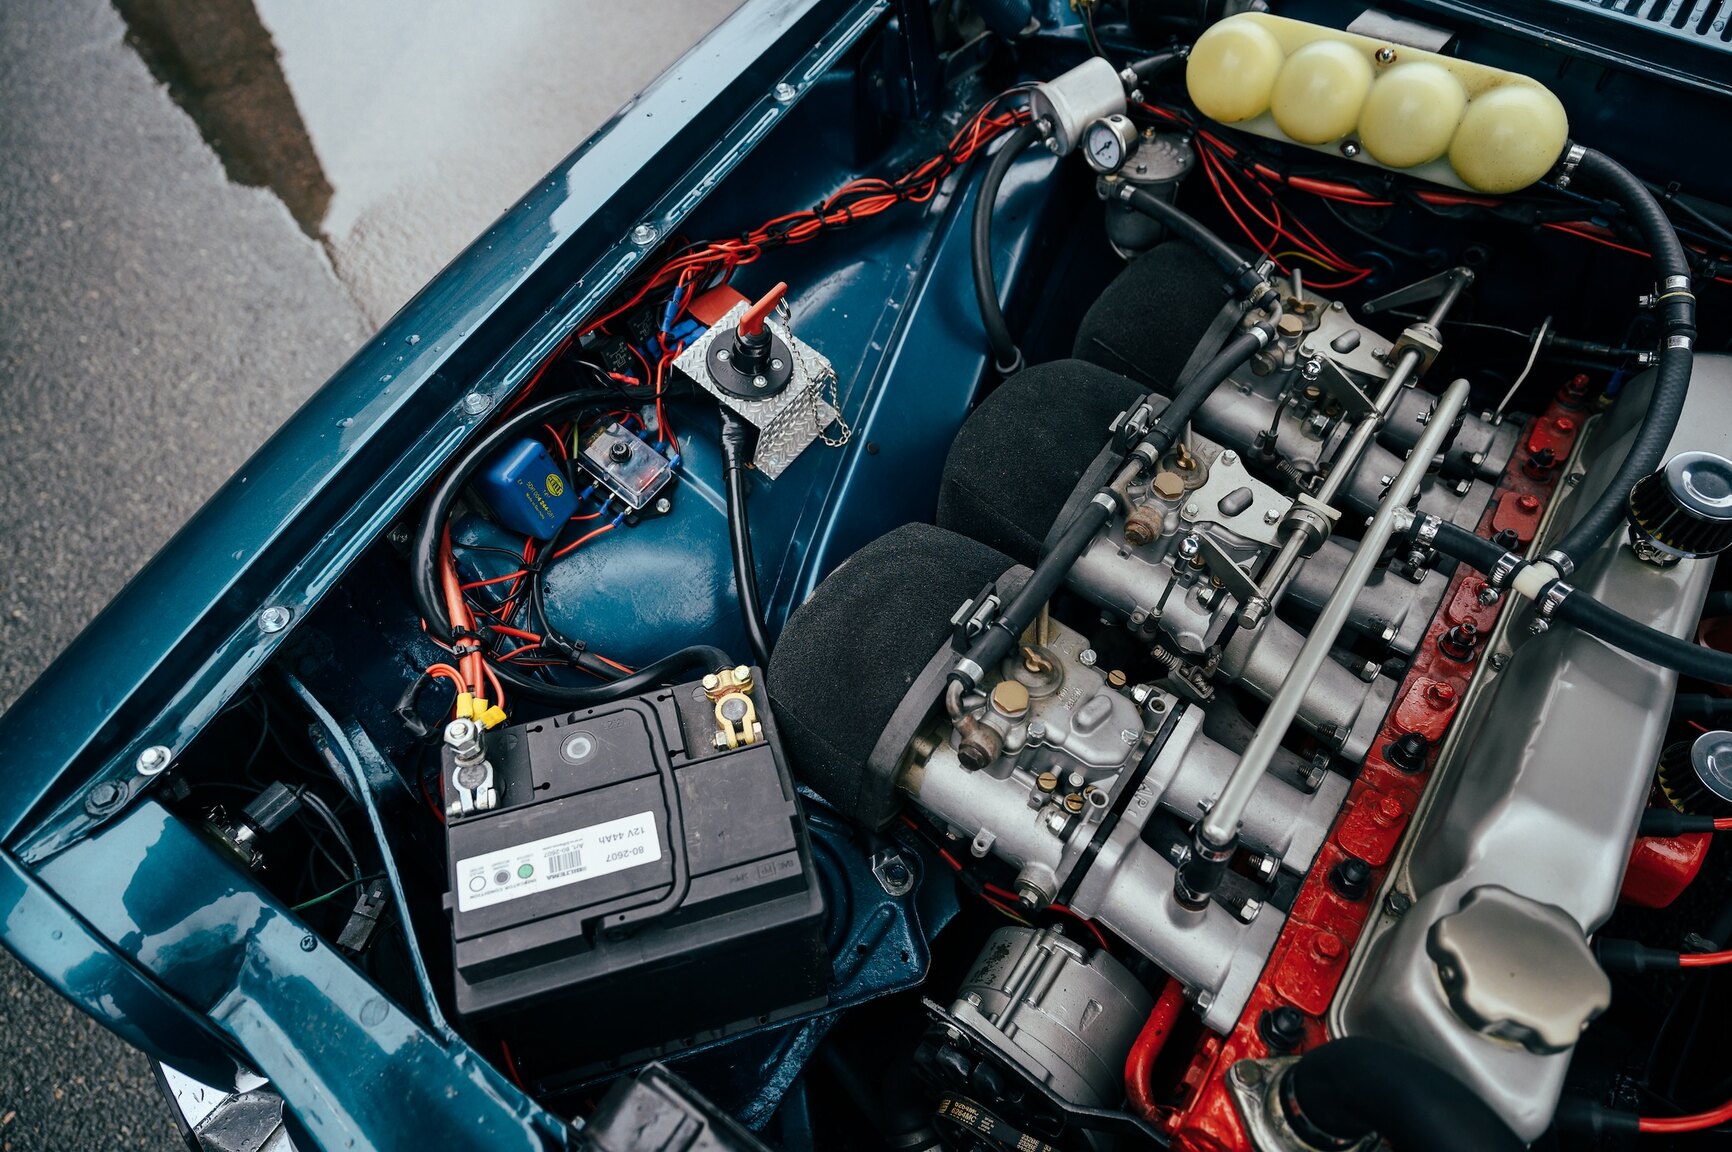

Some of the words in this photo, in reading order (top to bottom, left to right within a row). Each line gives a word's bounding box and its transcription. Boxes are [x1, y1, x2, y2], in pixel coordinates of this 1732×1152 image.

[627, 826, 645, 837] 12V
[599, 832, 625, 843] 44Ah
[606, 846, 644, 862] 80-2607
